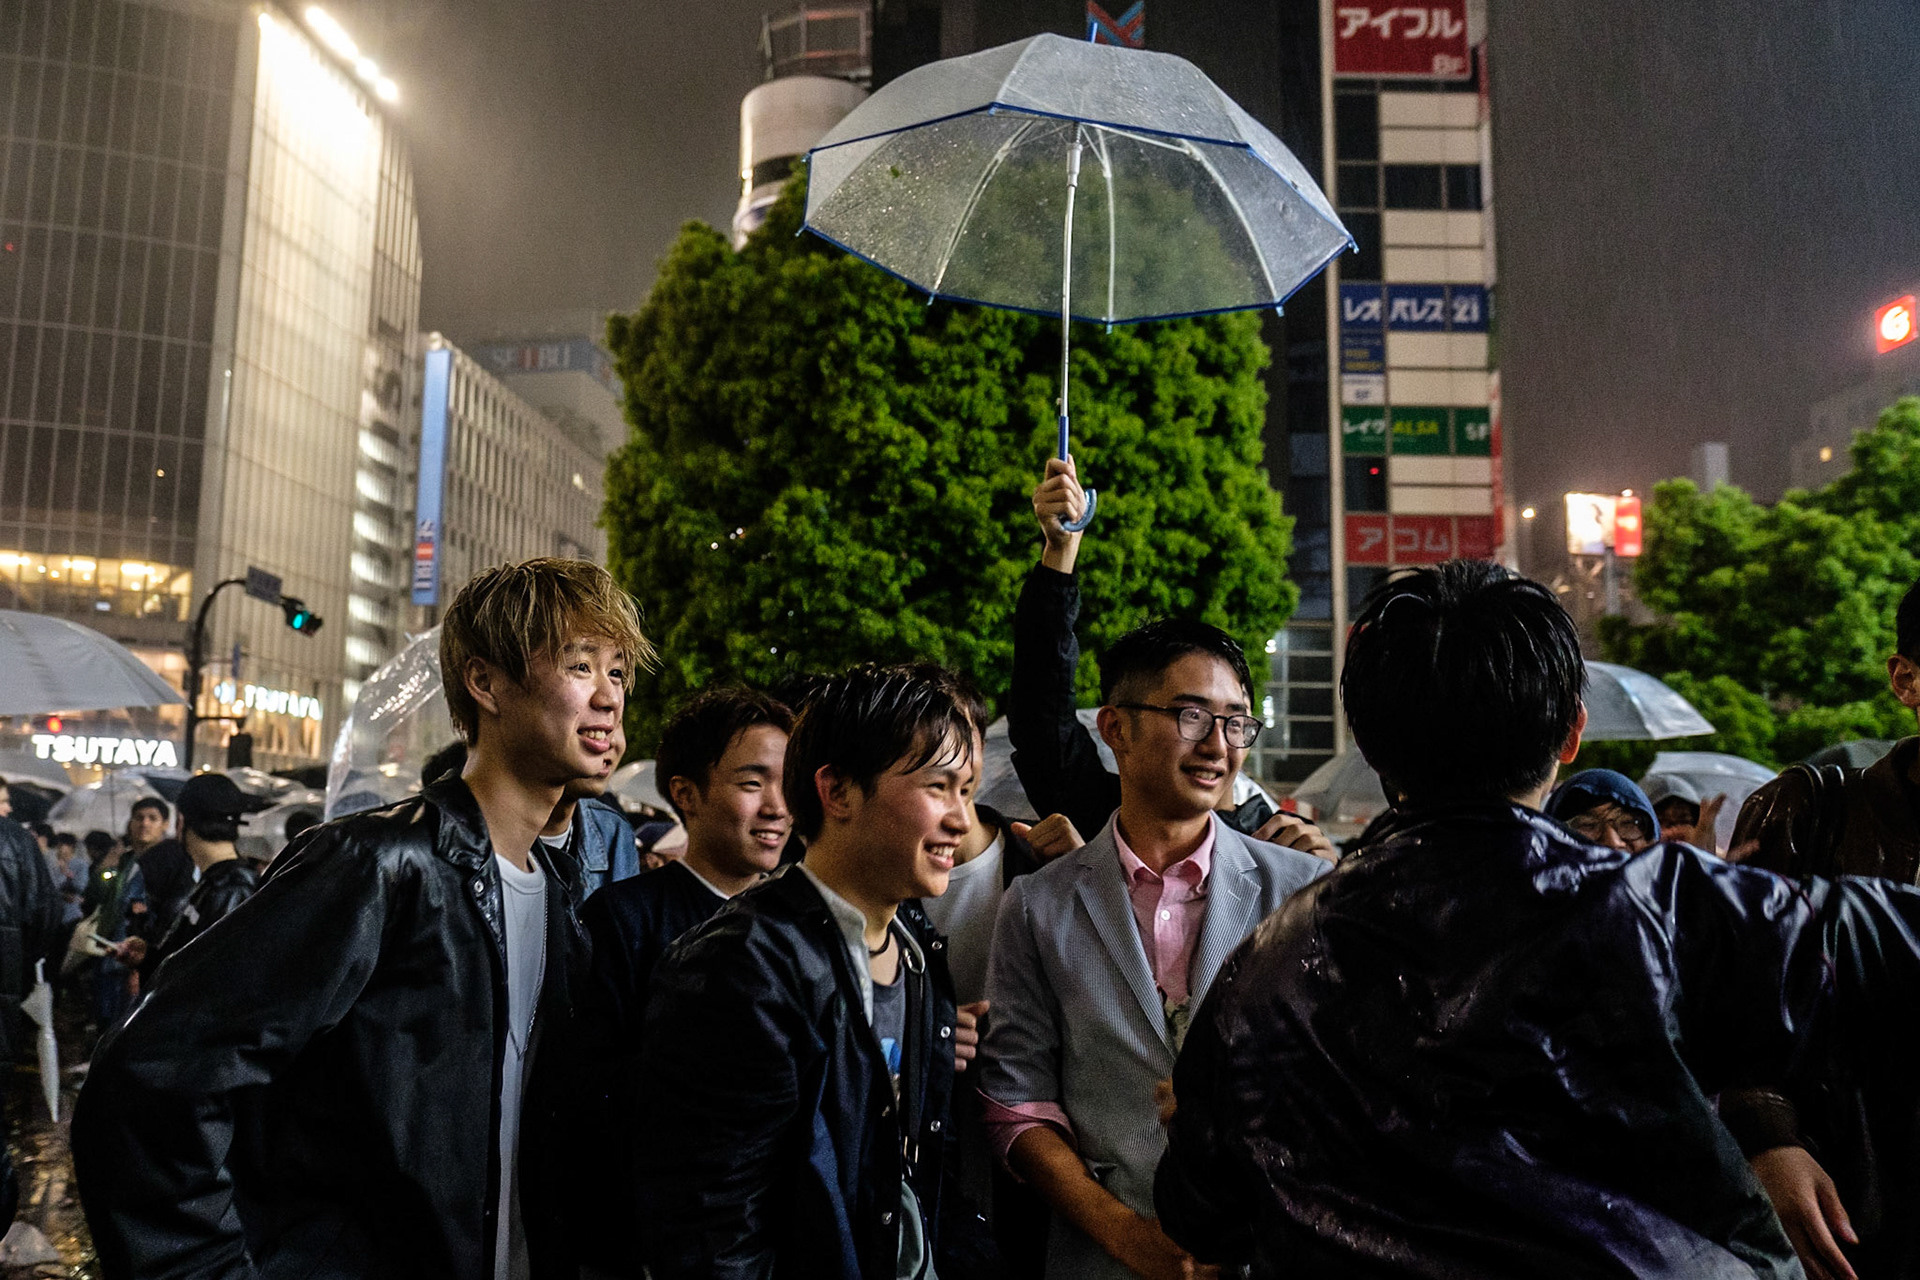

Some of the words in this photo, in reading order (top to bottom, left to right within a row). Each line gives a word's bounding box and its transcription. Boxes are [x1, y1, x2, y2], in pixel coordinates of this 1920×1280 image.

[1338, 7, 1463, 39] アイフル
[1357, 526, 1449, 553] アコム
[244, 683, 323, 721] TSUTAYA
[31, 734, 178, 767] TSUTAYA
